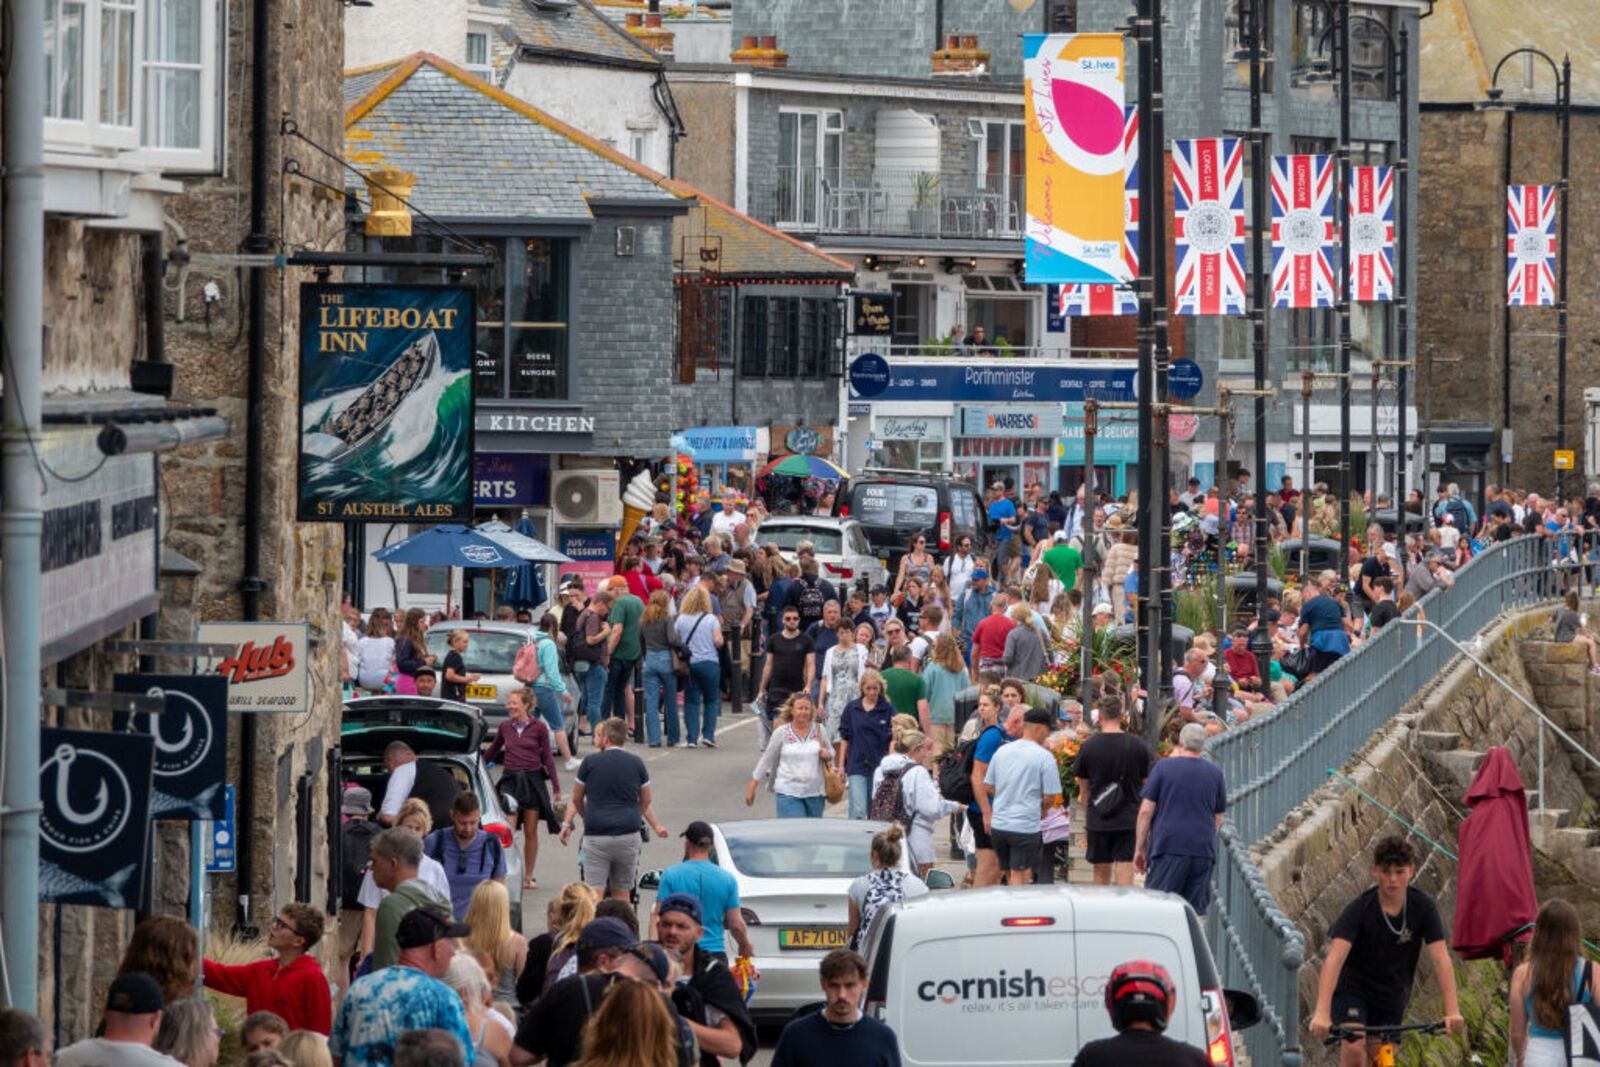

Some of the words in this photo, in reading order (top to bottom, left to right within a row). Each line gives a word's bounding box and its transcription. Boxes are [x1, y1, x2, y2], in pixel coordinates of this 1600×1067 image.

[1202, 149, 1212, 177] LONG
[1203, 178, 1213, 193] LIVE
[1206, 275, 1214, 296] KING
[319, 294, 344, 304] THE
[319, 306, 458, 330] LIFEBOAT
[318, 331, 368, 352] INN
[965, 366, 1035, 386] Porthminster
[490, 415, 595, 431] KITCHEN
[994, 413, 1034, 429] WARRENS
[317, 501, 335, 515] ST
[342, 502, 410, 517] AUSTELL
[414, 503, 454, 517] ALES
[566, 548, 607, 556] DESSERTS
[256, 696, 296, 705] SEAFOOD
[1017, 1000, 1030, 1011] all
[1034, 1000, 1071, 1011] taken
[1071, 999, 1099, 1009] care
